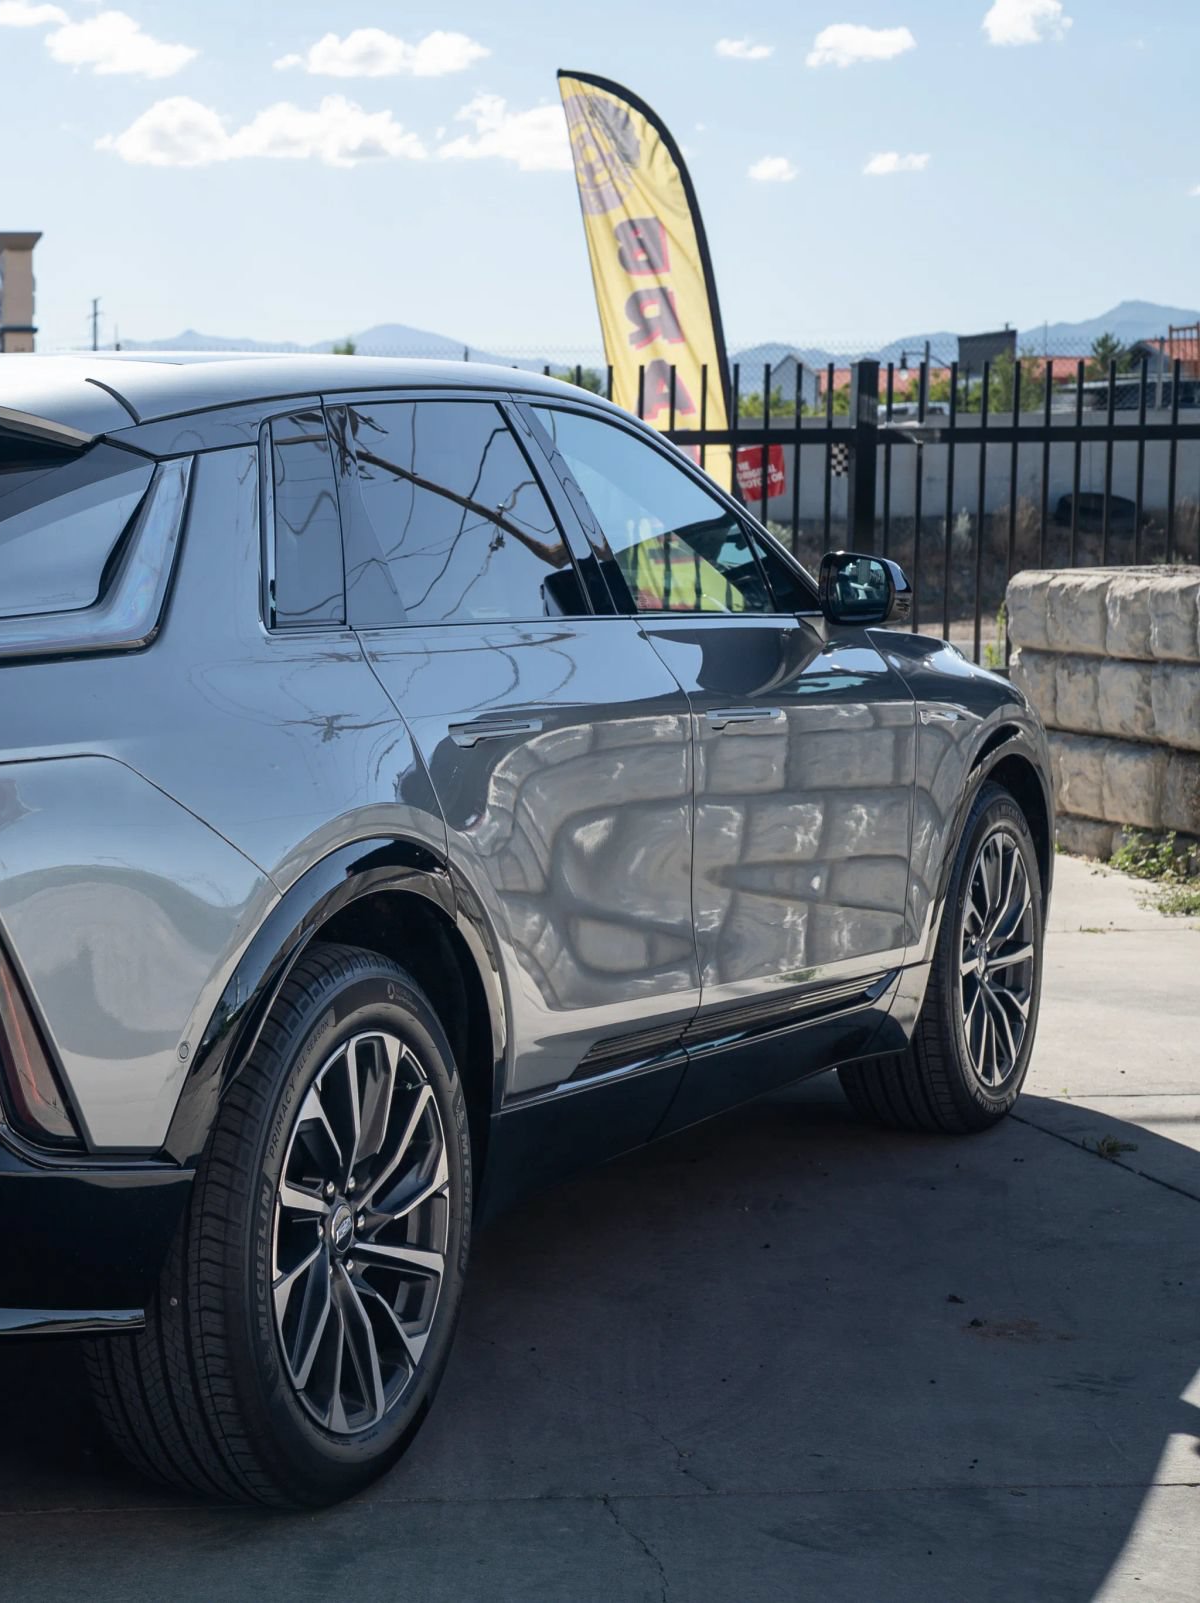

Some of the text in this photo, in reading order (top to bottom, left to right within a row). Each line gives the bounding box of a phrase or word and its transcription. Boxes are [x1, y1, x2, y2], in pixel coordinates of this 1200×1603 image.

[267, 1077, 297, 1160] PRIMACY
[305, 1018, 330, 1057] SEASON
[256, 1183, 273, 1342] MICHELIN
[461, 1133, 472, 1270] MICHELIN
